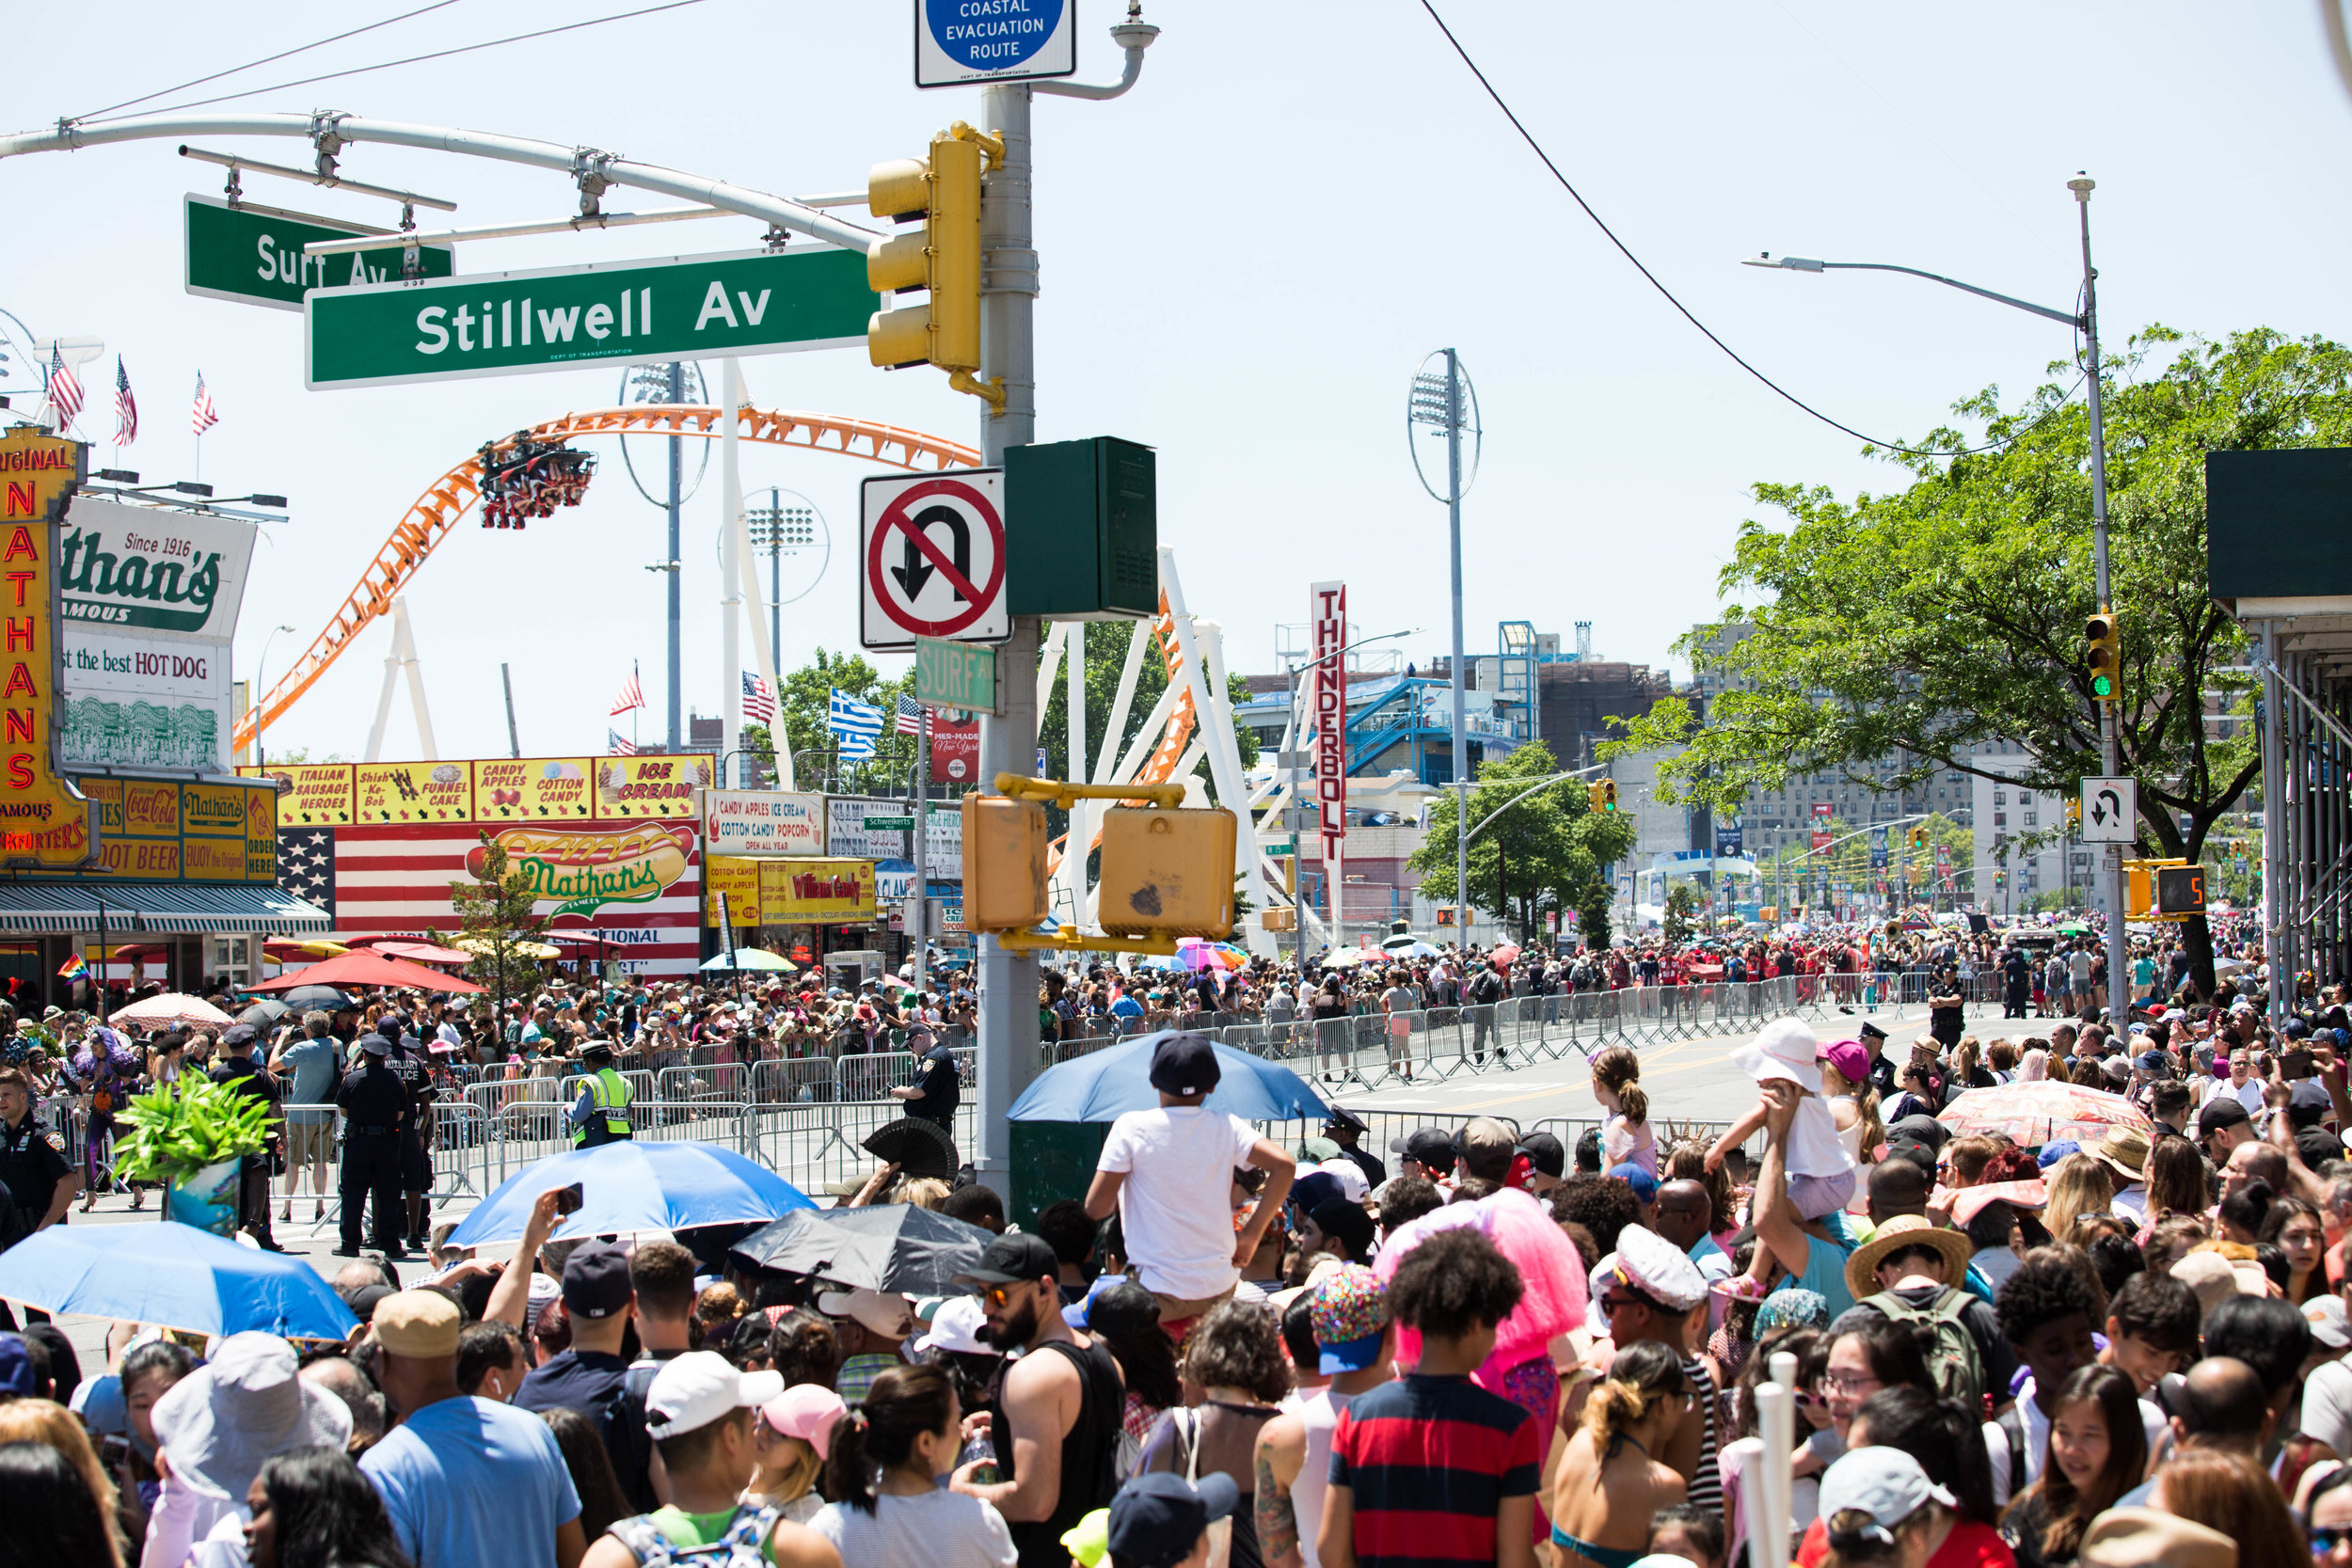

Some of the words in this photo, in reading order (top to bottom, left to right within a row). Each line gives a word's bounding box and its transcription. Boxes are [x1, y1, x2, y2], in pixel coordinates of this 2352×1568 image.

[960, 0, 1030, 18] COASTAL
[946, 18, 1043, 40] EVACUATION
[970, 42, 1020, 59] ROUTE
[984, 69, 1030, 77] TRANSPORTATION
[348, 251, 387, 285] Av
[414, 286, 653, 355] Stillwell
[694, 280, 772, 331] Av
[580, 348, 632, 357] TRANSPORTATION
[0, 446, 70, 472] IGINAL
[125, 532, 158, 553] Since
[163, 537, 191, 557] 1916
[60, 527, 220, 606] than's
[2, 482, 38, 789] NATHANS
[76, 648, 99, 670] the
[103, 649, 132, 673] best
[135, 652, 169, 676] HOT
[172, 656, 207, 679] DOG
[920, 645, 976, 699] SURF
[978, 656, 993, 679] AV
[1318, 591, 1339, 860] THUNDERBOLT
[934, 740, 955, 752] New
[957, 740, 978, 754] York
[299, 769, 345, 782] ITALIAN
[360, 771, 389, 783] Shish
[483, 764, 526, 776] CANDY
[637, 763, 674, 780] ICE
[422, 783, 468, 794] FUNNEL
[481, 775, 527, 787] APPLES
[536, 778, 584, 790] COTTON
[106, 785, 120, 800] CUT
[295, 784, 350, 796] SAUSAGE
[363, 785, 386, 795] -Ke-
[540, 790, 582, 802] CANDY
[618, 783, 691, 800] CREAM
[183, 792, 245, 818] Nathan's
[300, 798, 346, 809] HEROES
[364, 796, 385, 806] Bob
[429, 795, 462, 806] CAKE
[100, 803, 121, 826] IES
[720, 800, 742, 815] CANDY
[745, 802, 769, 816] APPLES
[771, 803, 781, 816] ICE
[783, 804, 805, 817] CREAM
[944, 813, 961, 828] HERO
[721, 822, 750, 836] COTTON
[752, 823, 775, 836] CANDY
[778, 823, 810, 838] POPCORN
[248, 840, 275, 853] ORDER
[746, 841, 760, 850] OPEN
[762, 842, 771, 850] ALL
[773, 842, 788, 850] YEAR
[136, 846, 179, 870] BEER
[186, 845, 212, 867] ENJOY
[248, 858, 275, 873] HERE!
[737, 867, 756, 876] CANDY
[519, 856, 656, 896] Nathan's
[711, 881, 731, 890] CANDY
[792, 873, 833, 900] Williams
[834, 873, 860, 906] Candy
[2191, 878, 2202, 904] 5
[568, 897, 600, 909] FAMOUS
[1448, 912, 1453, 922] 5
[384, 1060, 418, 1069] AUXILIARY
